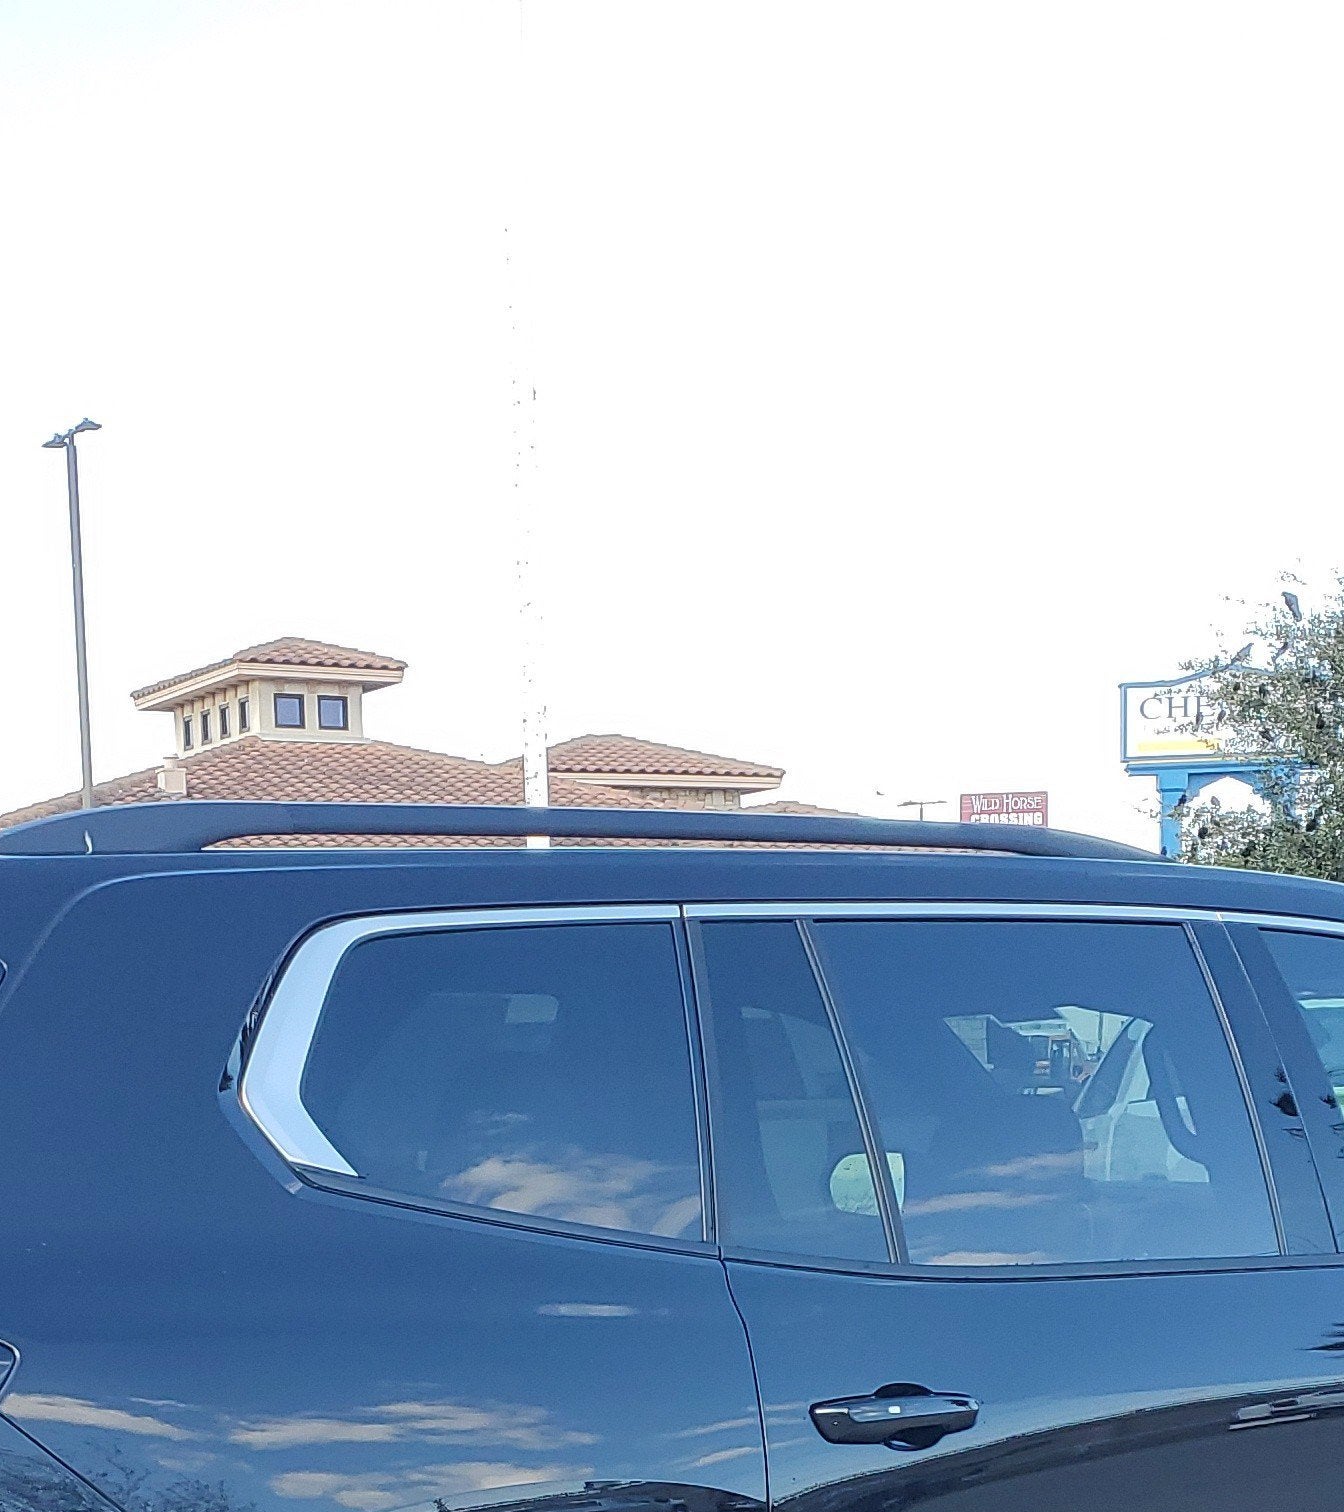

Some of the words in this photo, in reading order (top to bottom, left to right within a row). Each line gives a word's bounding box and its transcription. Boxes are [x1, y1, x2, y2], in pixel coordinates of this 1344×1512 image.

[971, 795, 1000, 814] WILD
[1002, 794, 1043, 813] HORSE
[970, 812, 1043, 825] CROSSING
